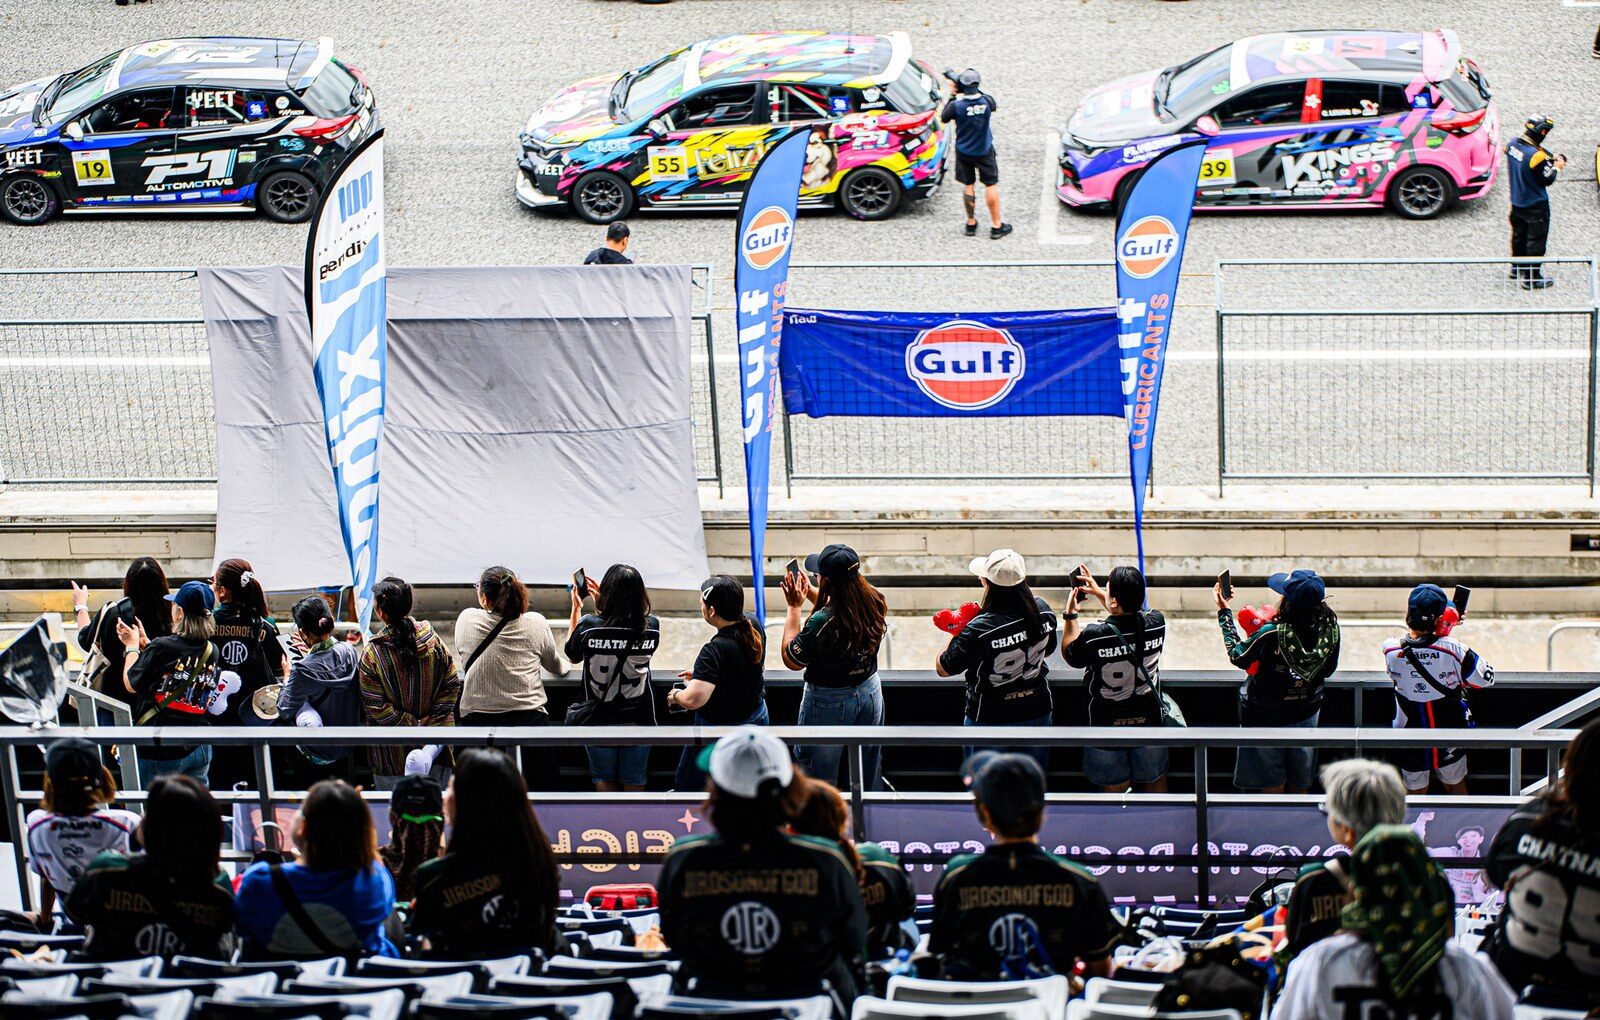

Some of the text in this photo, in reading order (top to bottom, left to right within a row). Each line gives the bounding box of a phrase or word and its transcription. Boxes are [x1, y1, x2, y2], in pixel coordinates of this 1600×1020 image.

[191, 91, 237, 110] YEET
[6, 149, 43, 166] YEET
[140, 149, 237, 185] P1
[657, 157, 680, 173] 55
[1281, 141, 1396, 189] KINGS
[82, 162, 105, 178] 19
[1203, 161, 1228, 178] 39
[146, 178, 234, 193] AUTOMOTIVE
[338, 170, 373, 224] 100
[744, 222, 790, 252] Gulf
[1122, 238, 1175, 257] Gulf
[914, 348, 1018, 378] Gulf
[1132, 293, 1169, 449] LUBRICANTS
[588, 638, 655, 650] CHATNHA
[589, 654, 652, 703] 95
